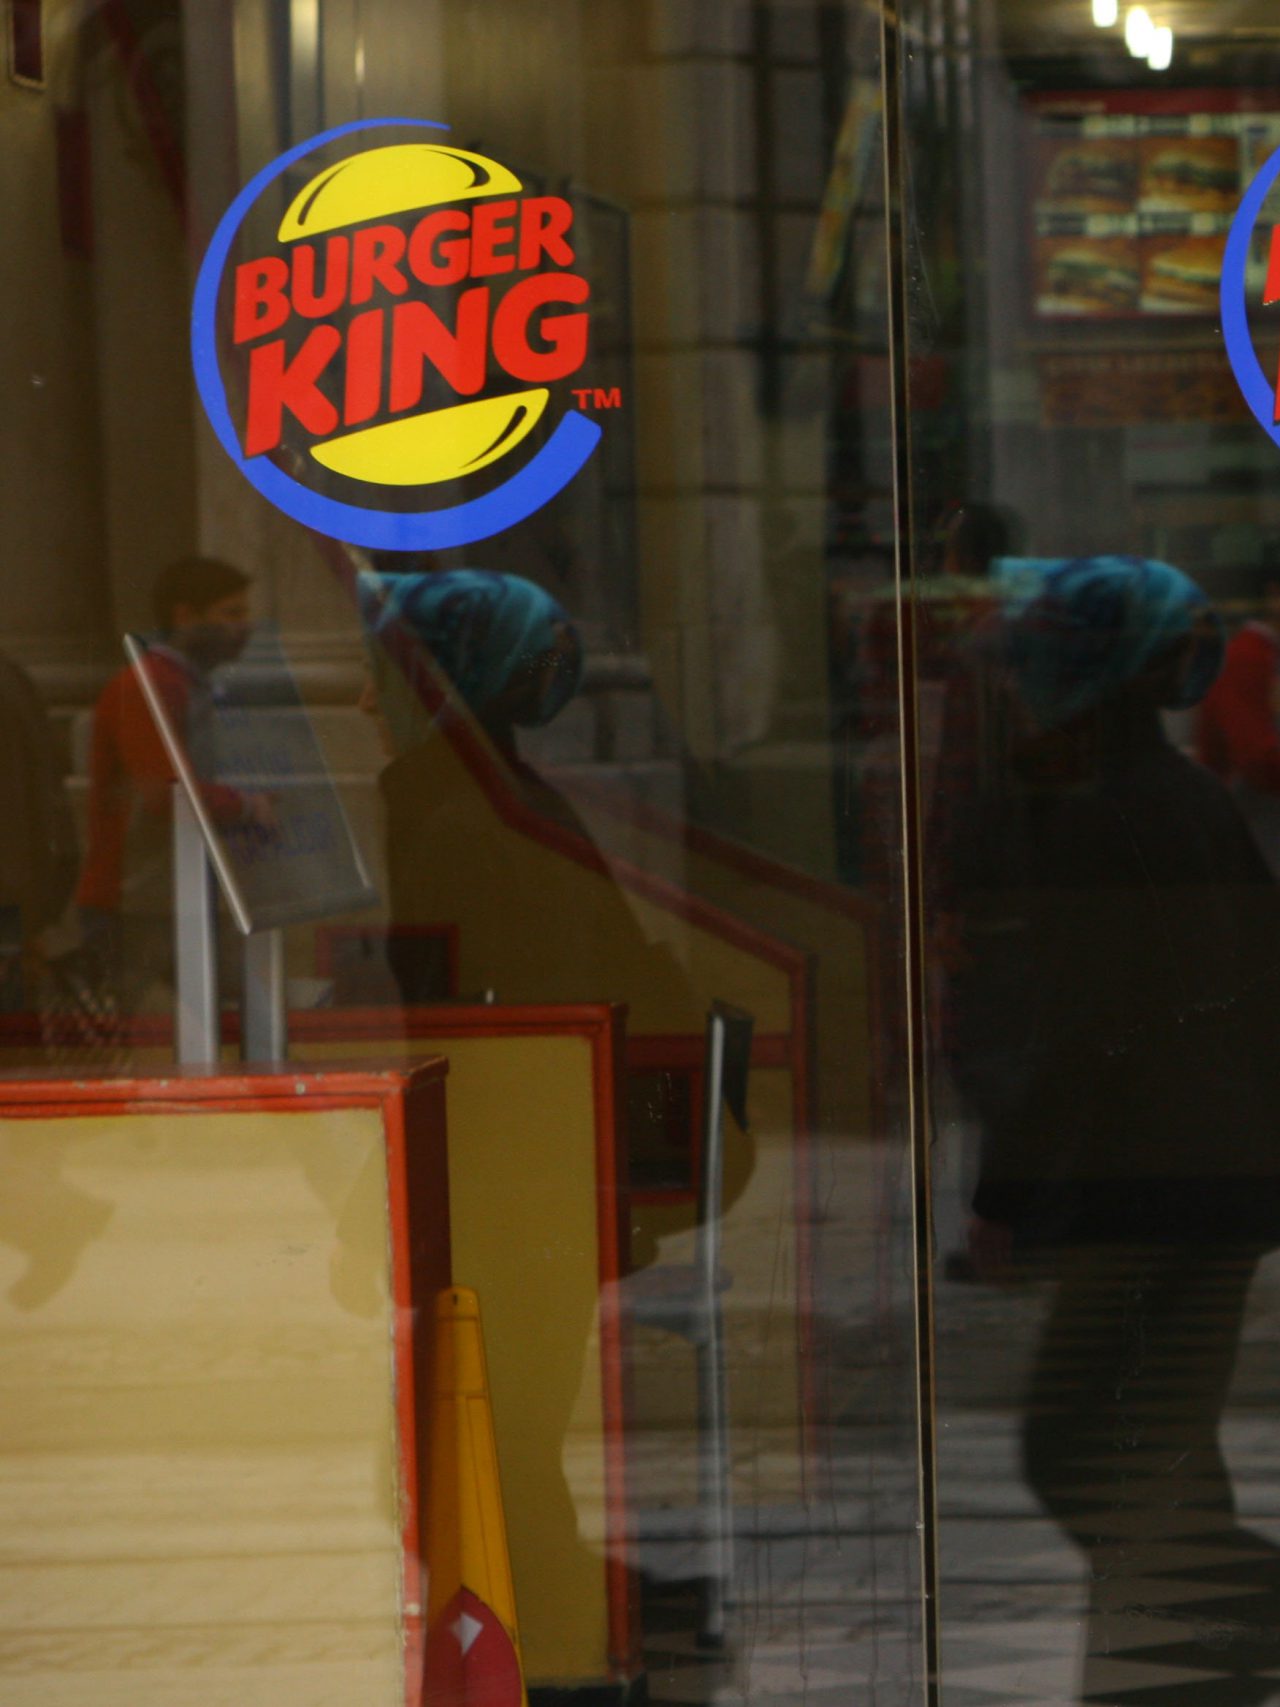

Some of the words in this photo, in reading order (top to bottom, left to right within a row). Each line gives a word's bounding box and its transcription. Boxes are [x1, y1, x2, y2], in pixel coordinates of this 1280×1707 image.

[233, 195, 576, 345] BURGER
[244, 271, 591, 457] KING
[571, 387, 622, 410] TM
